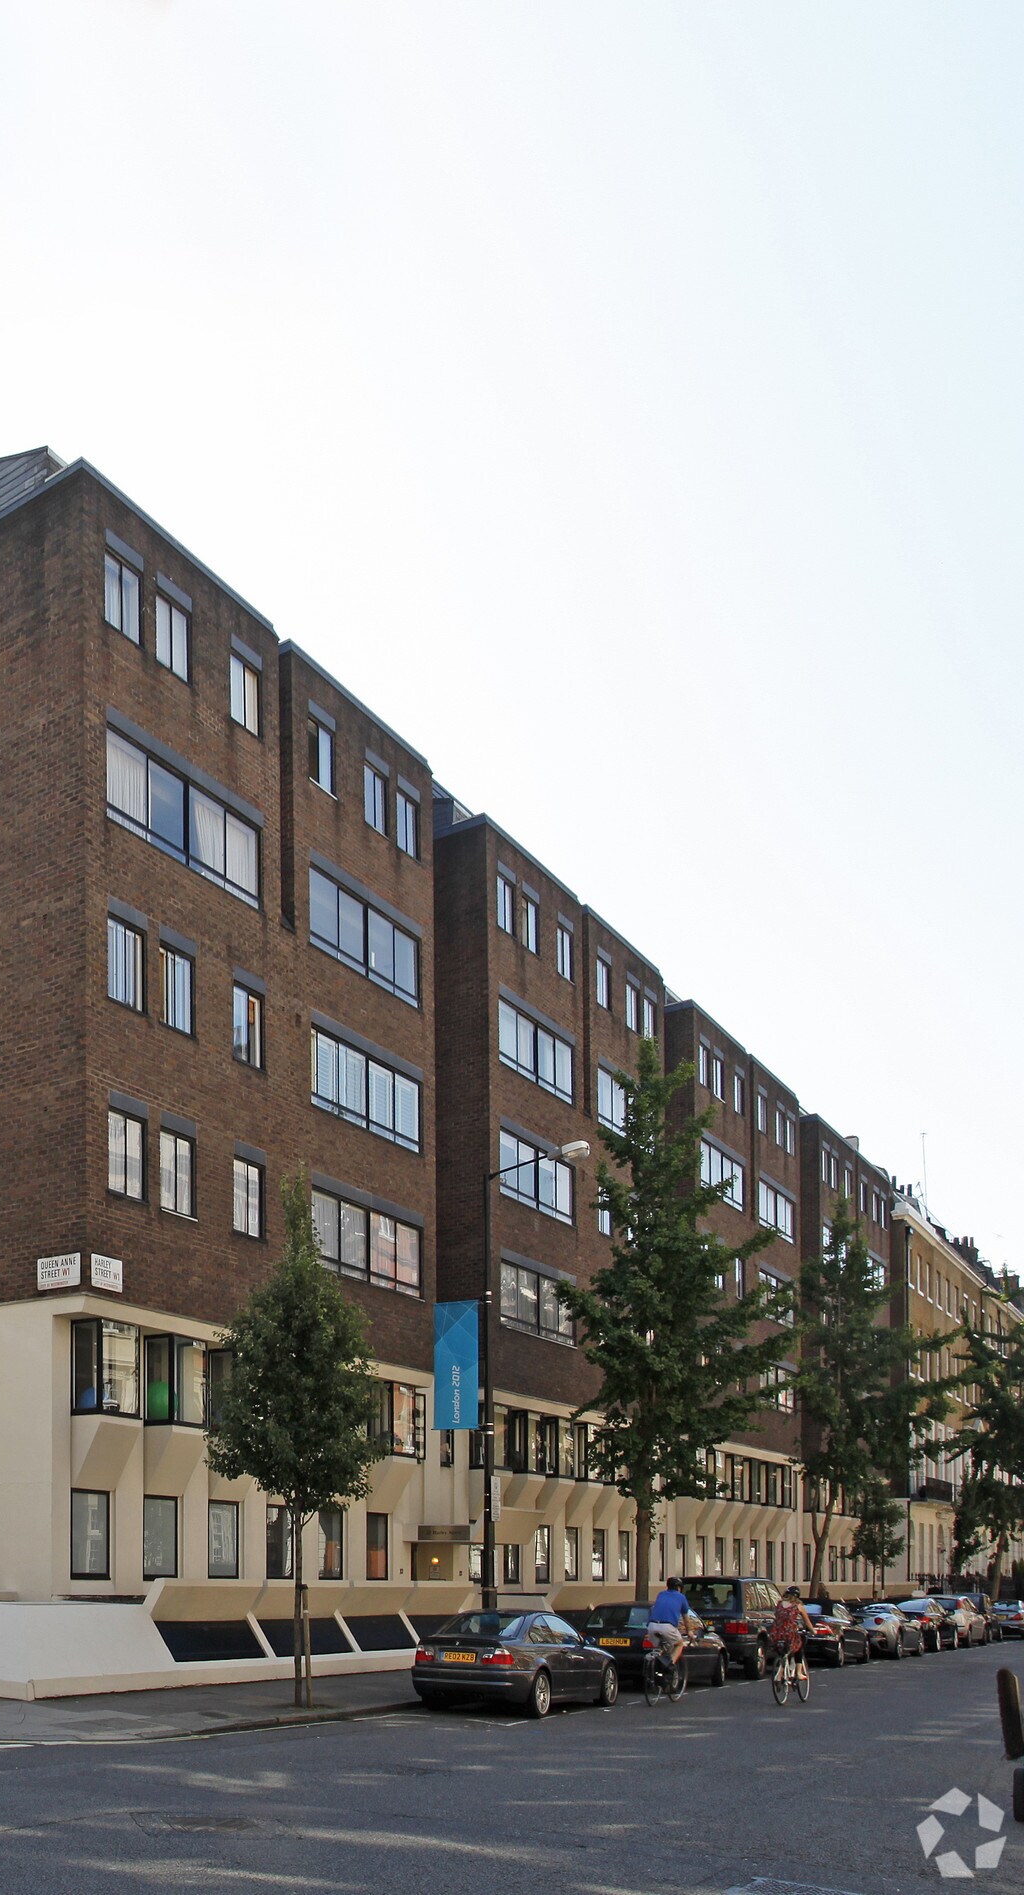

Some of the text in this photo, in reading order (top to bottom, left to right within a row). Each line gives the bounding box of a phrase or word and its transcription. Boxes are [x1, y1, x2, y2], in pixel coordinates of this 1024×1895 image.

[40, 1256, 77, 1270] QUEEN ANNE
[94, 1257, 112, 1270] HARLEY
[40, 1268, 70, 1280] STREET W1
[94, 1267, 120, 1281] STREET W1
[451, 1365, 460, 1424] London 2012
